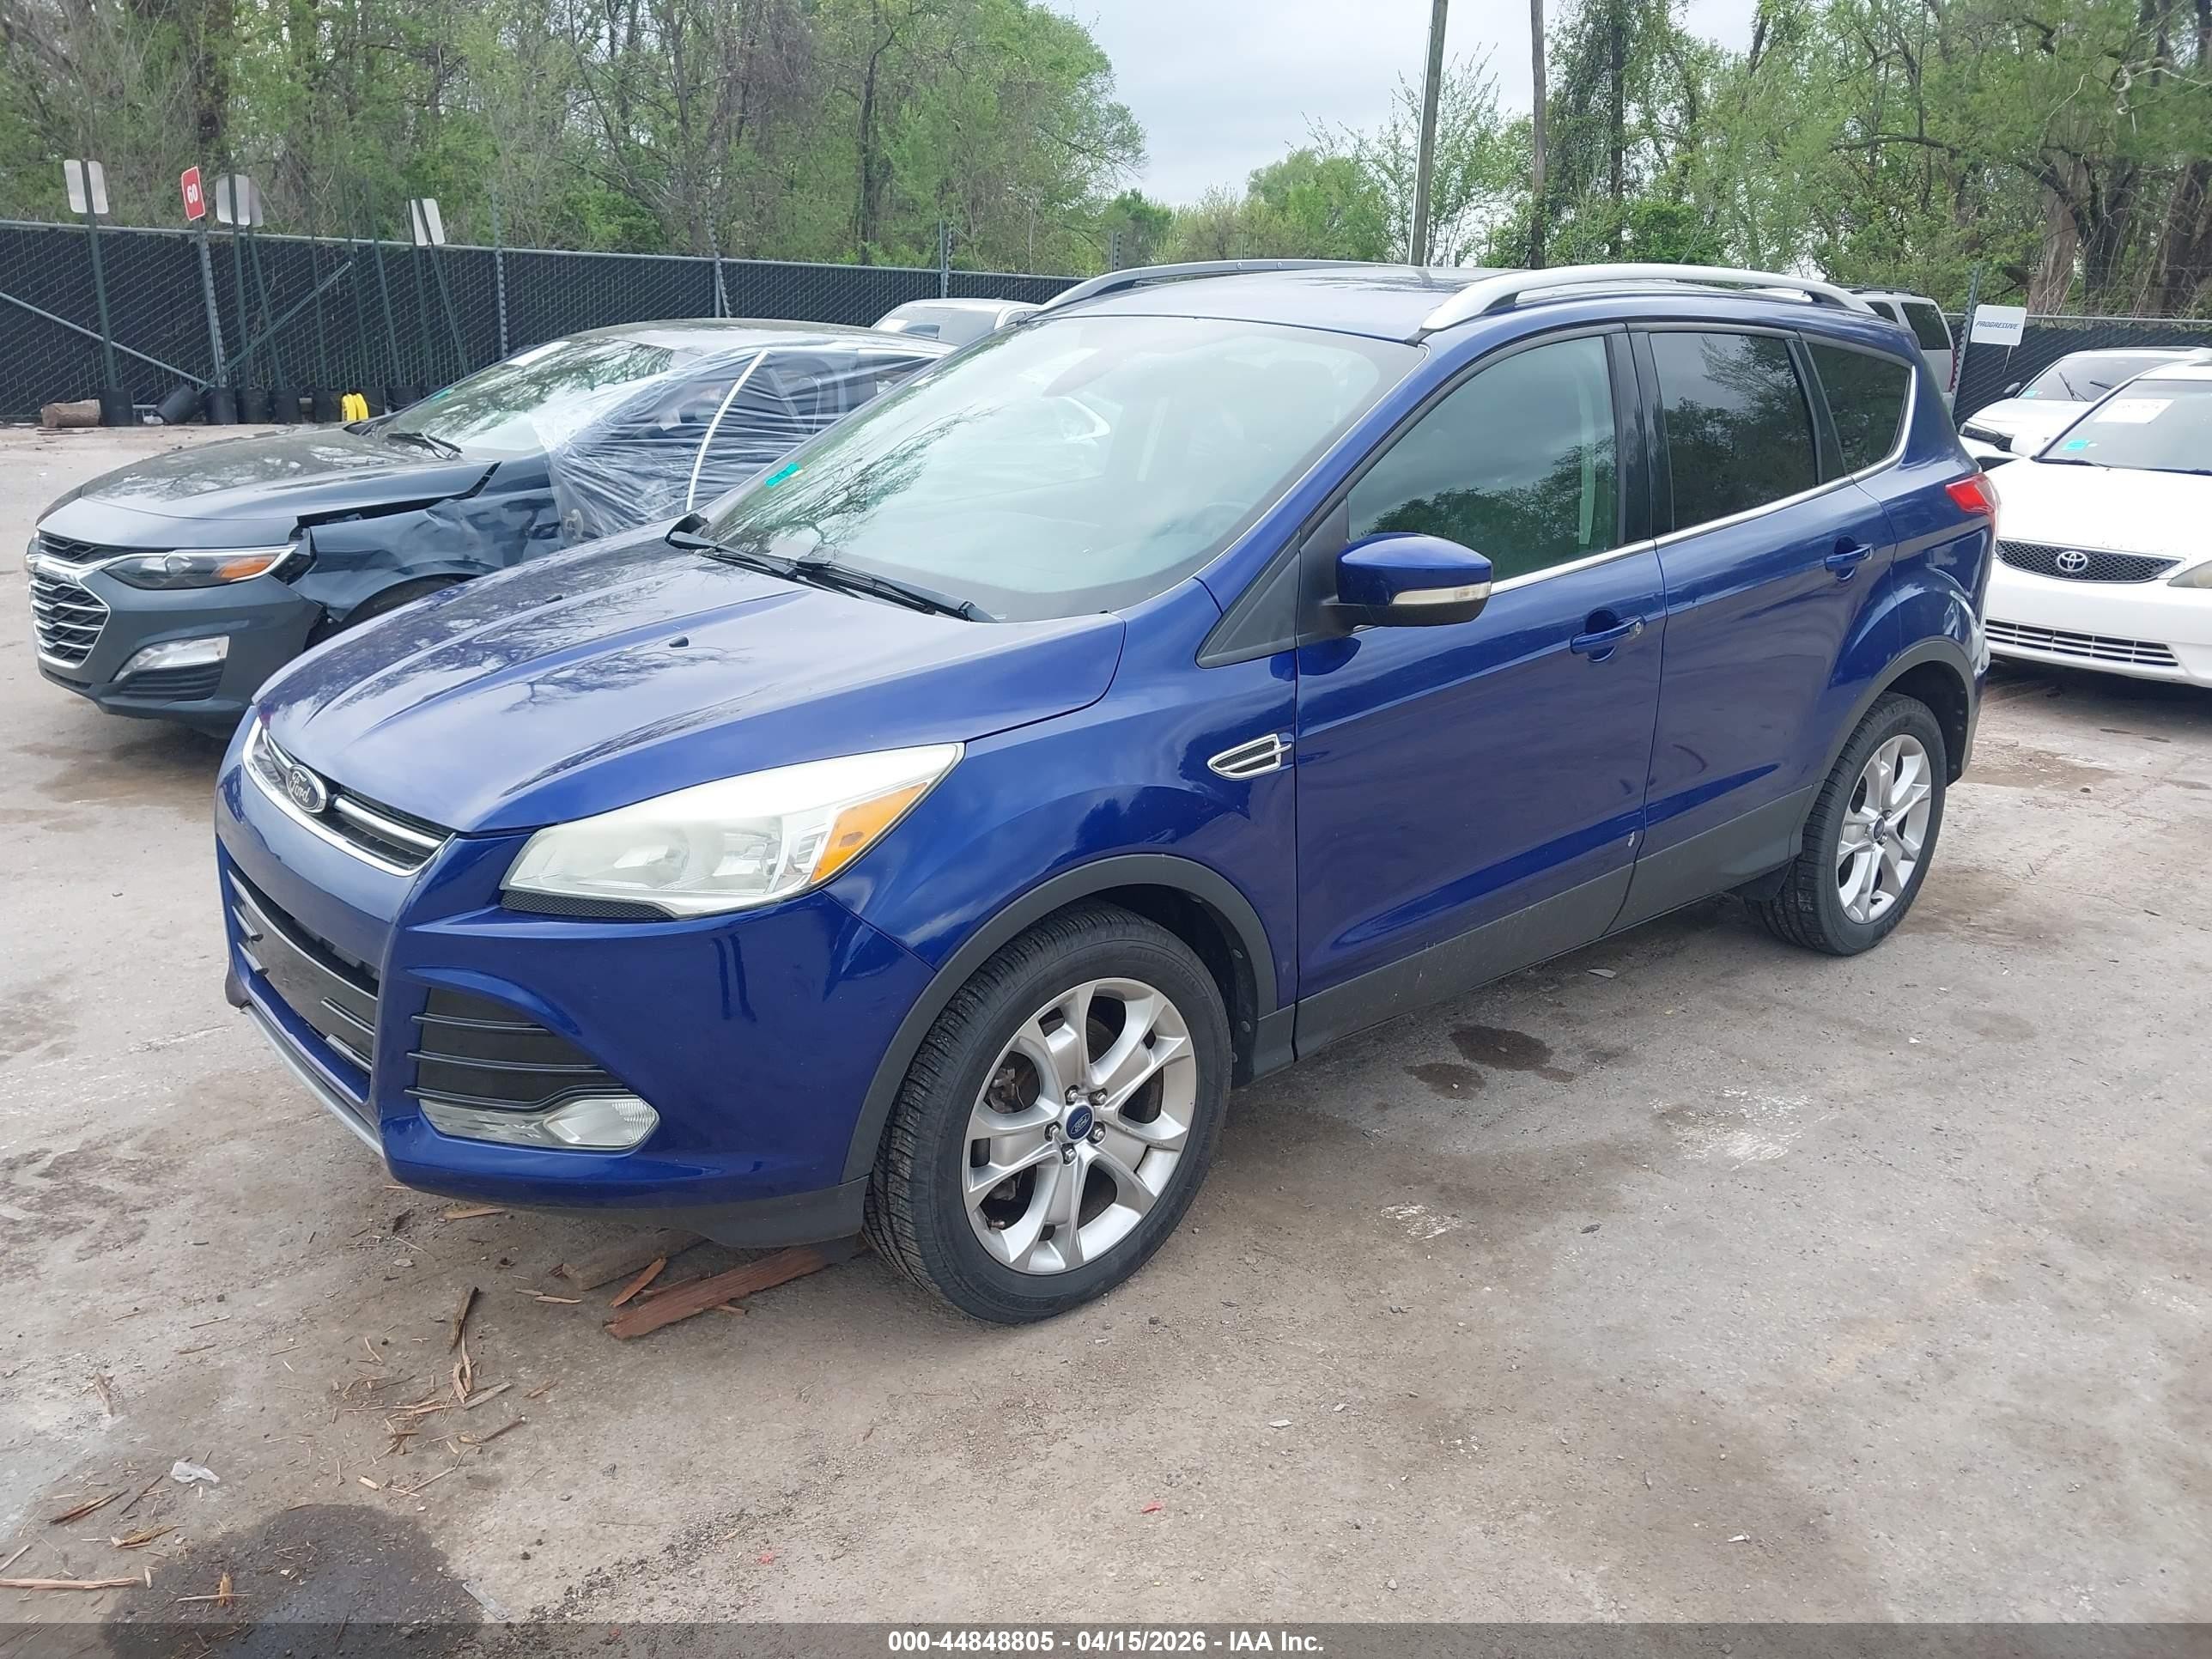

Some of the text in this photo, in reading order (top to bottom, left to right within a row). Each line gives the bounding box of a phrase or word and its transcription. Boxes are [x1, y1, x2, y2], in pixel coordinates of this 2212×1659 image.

[186, 183, 198, 204] 60
[1975, 320, 2021, 330] PROGRESSIVE
[289, 770, 311, 803] Ford
